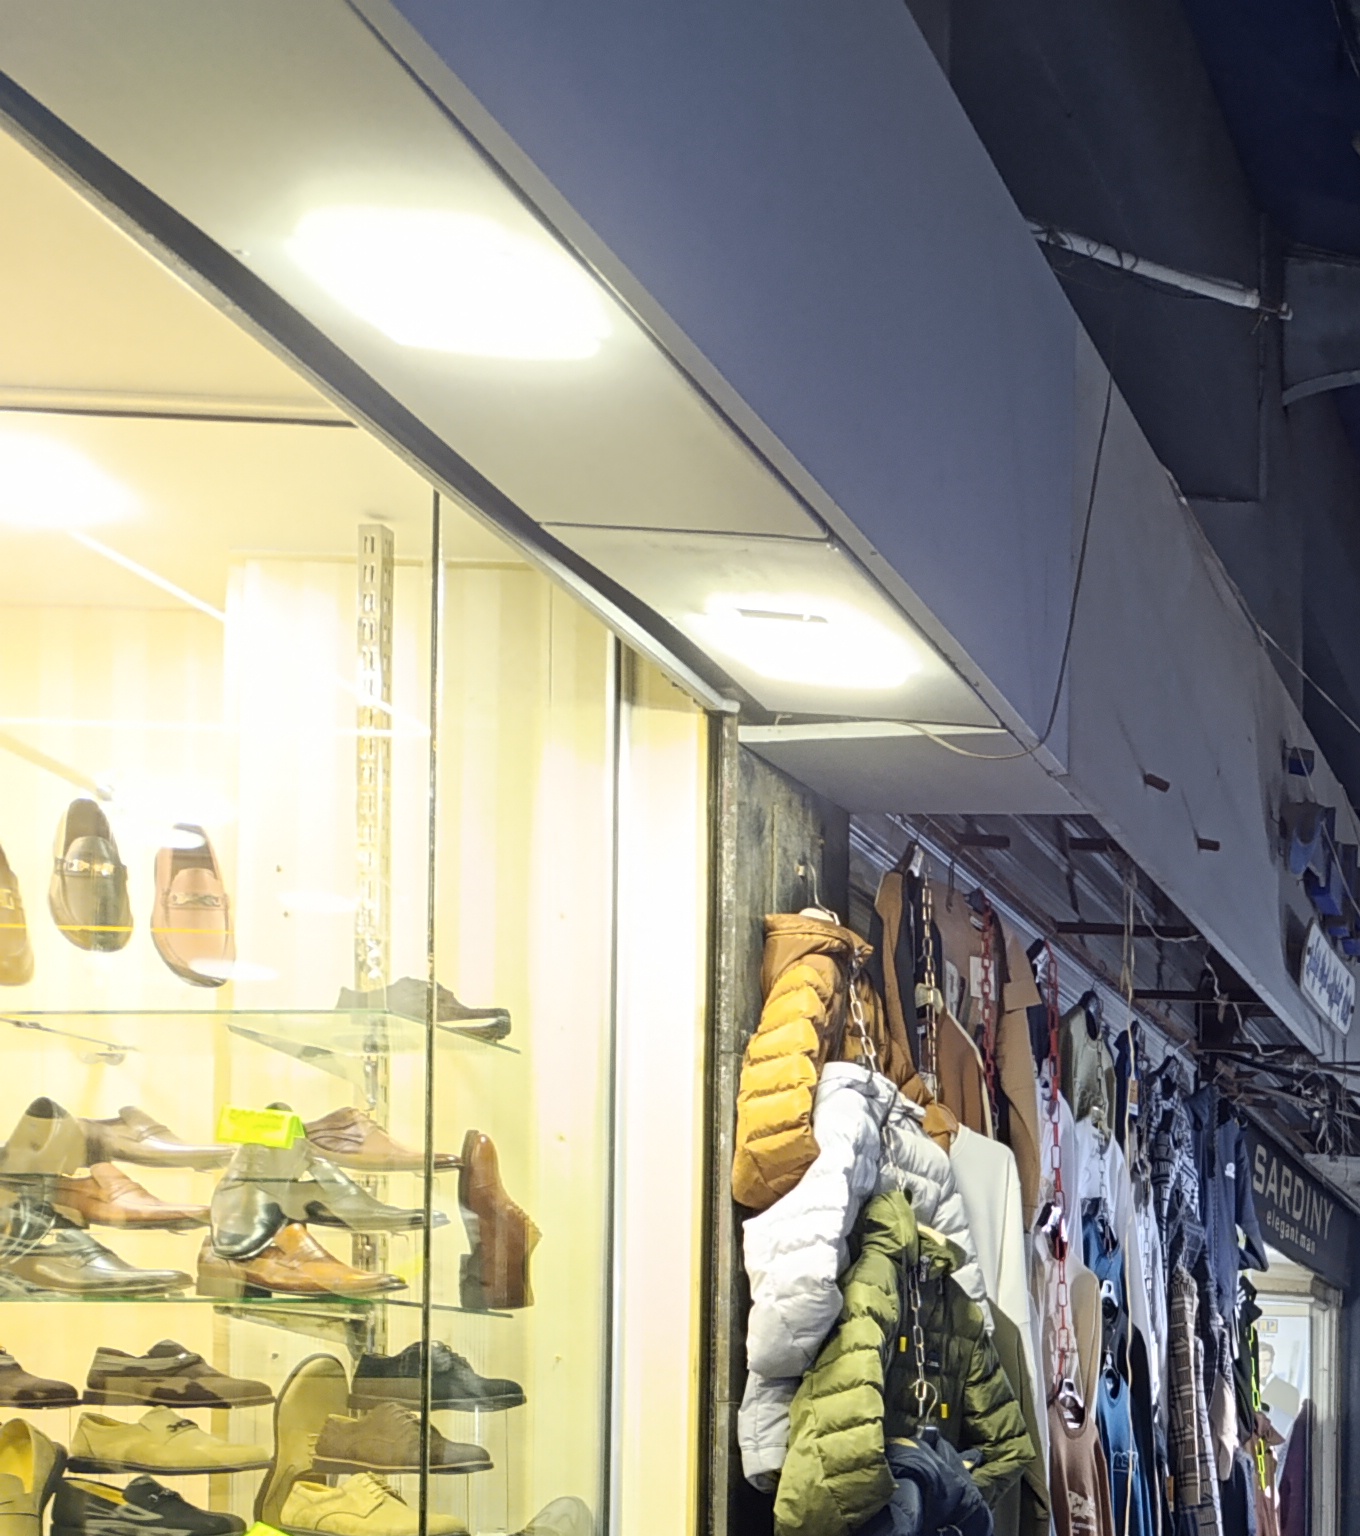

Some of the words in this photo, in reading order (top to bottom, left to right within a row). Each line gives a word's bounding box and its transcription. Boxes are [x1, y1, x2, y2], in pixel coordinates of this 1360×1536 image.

[1252, 1143, 1335, 1241] SARDINY
[1266, 1209, 1300, 1245] elegant
[1300, 1233, 1316, 1256] man
